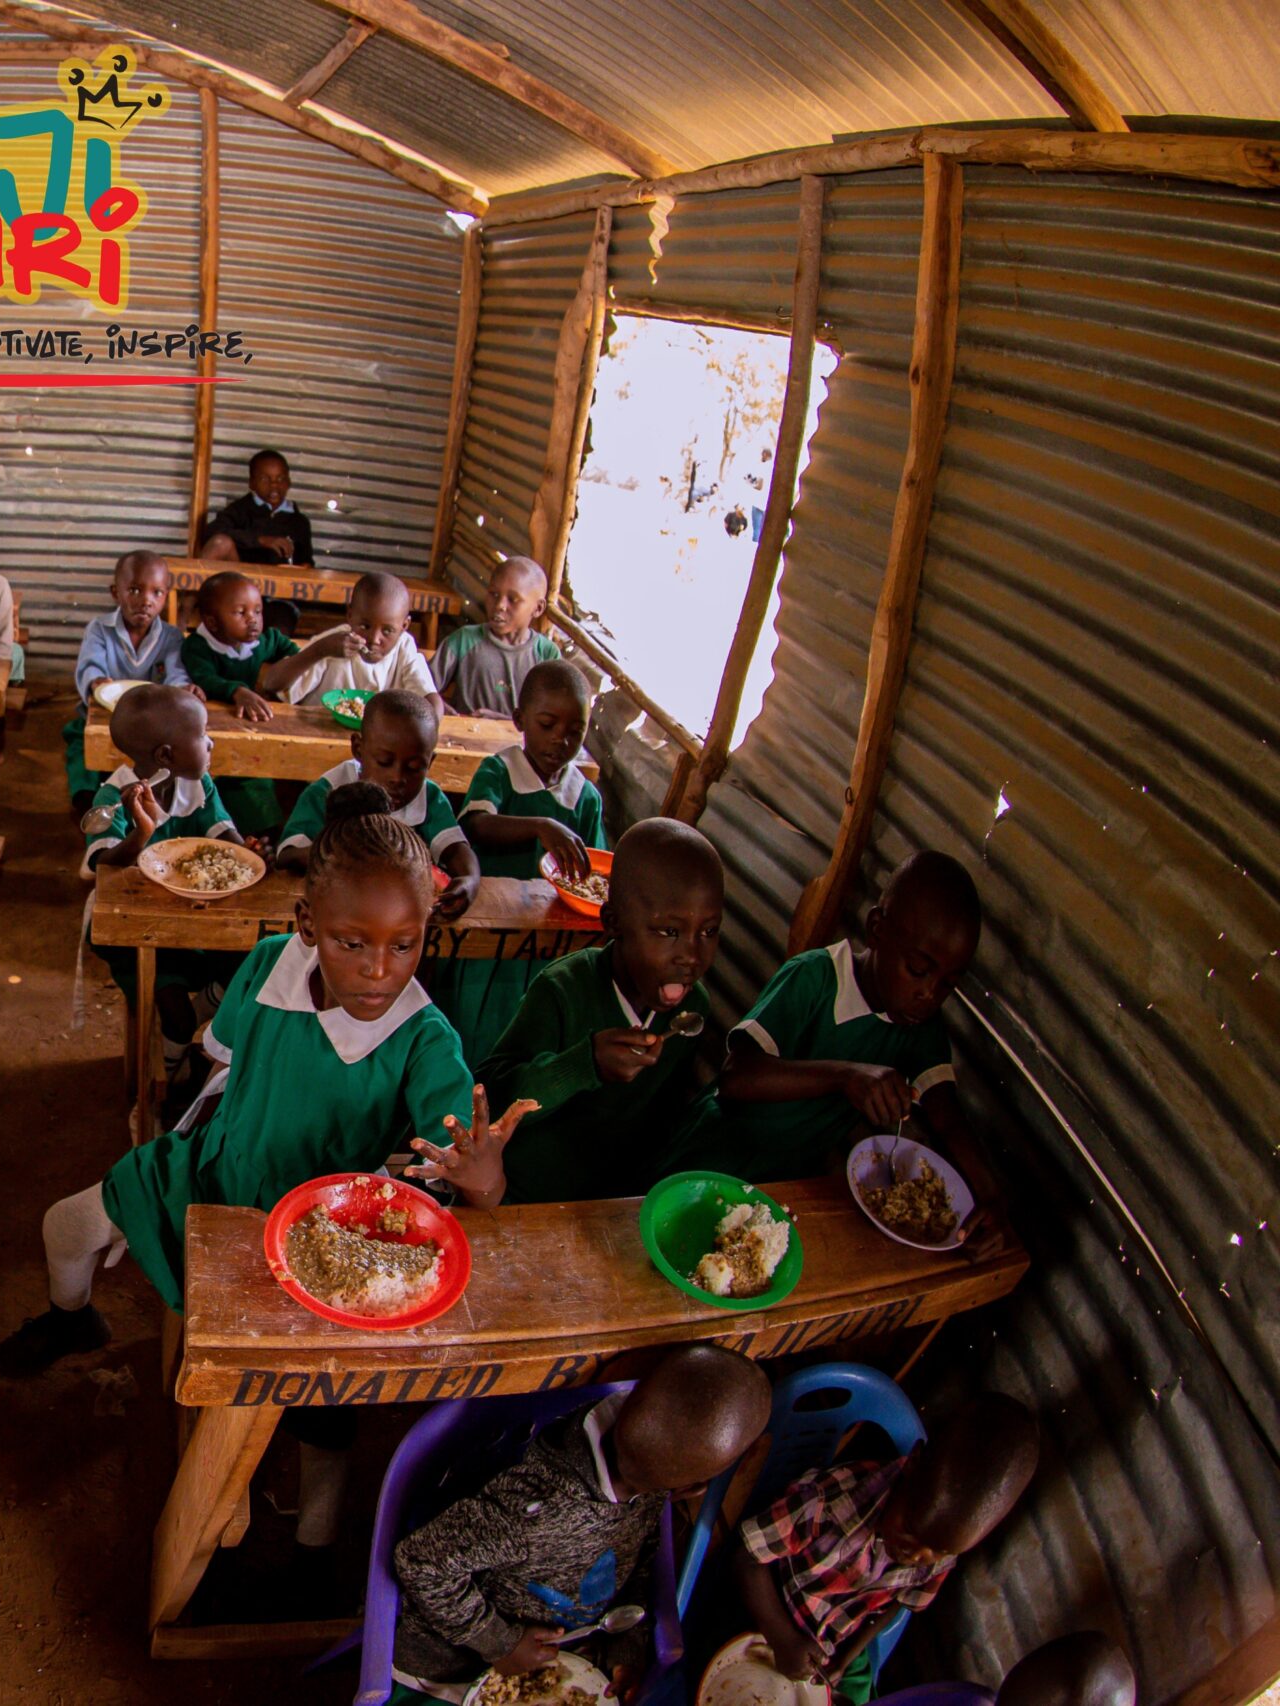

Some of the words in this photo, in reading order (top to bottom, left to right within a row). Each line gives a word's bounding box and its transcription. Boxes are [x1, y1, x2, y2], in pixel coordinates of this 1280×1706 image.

[291, 581, 324, 600] BY
[423, 926, 470, 960] BY
[231, 1364, 504, 1407] DONATED
